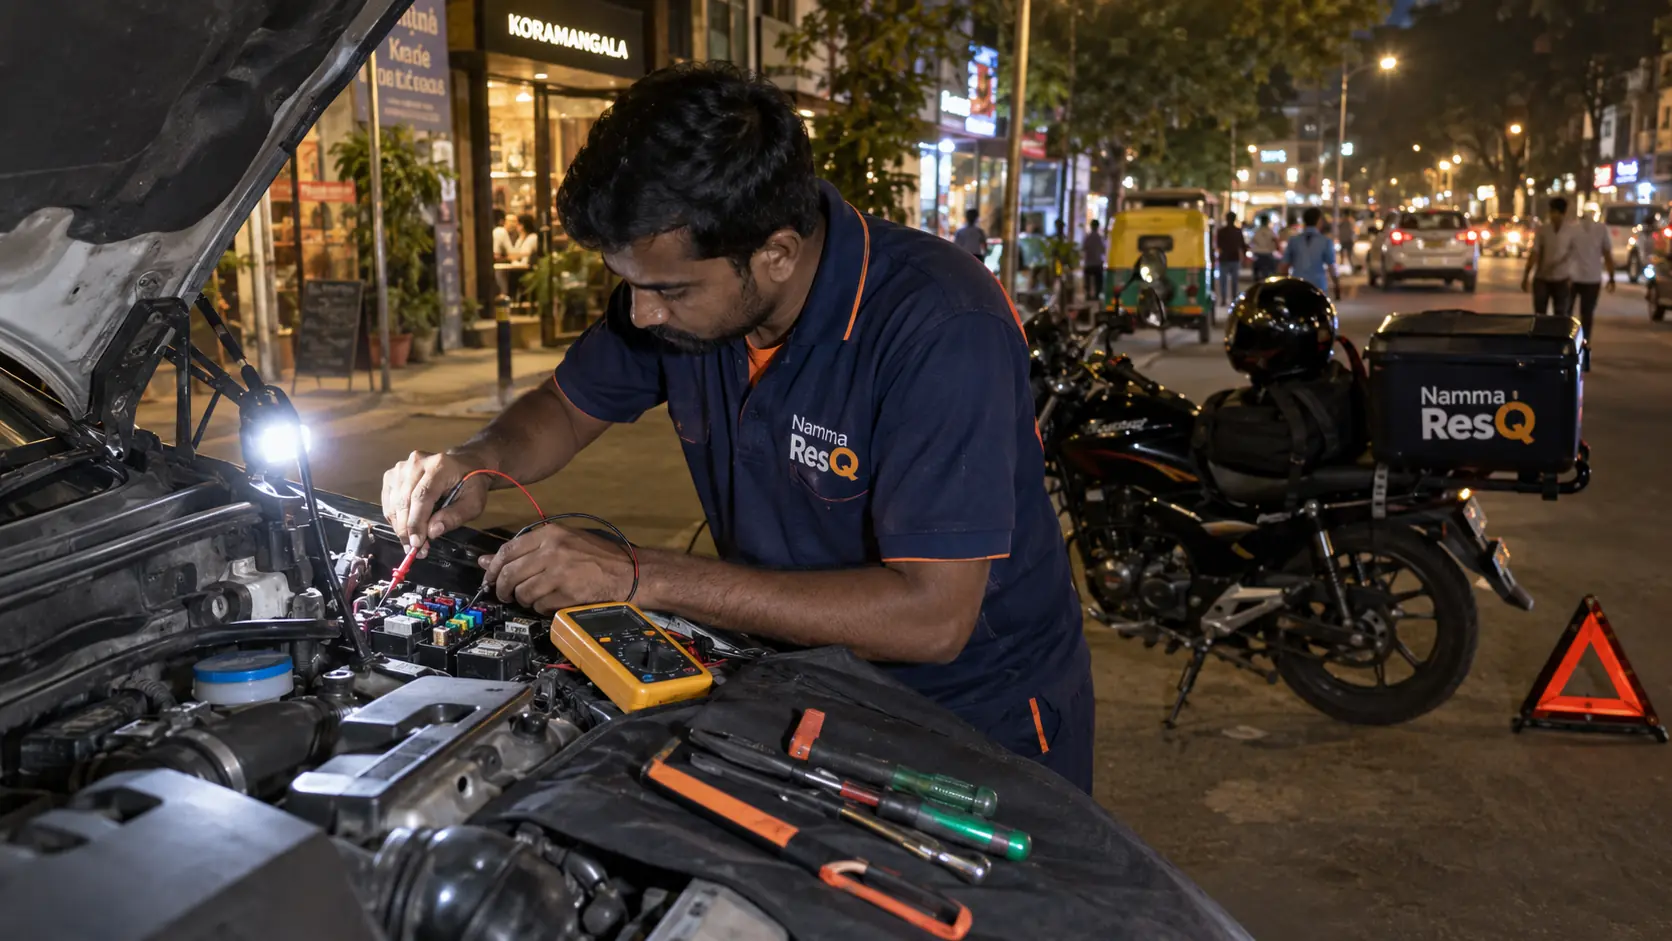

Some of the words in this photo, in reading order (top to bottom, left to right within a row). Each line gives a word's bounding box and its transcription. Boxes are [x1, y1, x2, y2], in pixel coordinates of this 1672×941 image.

[508, 13, 628, 60] KORAMANGALA
[1421, 386, 1505, 405] Namma
[792, 413, 848, 447] Namma
[1421, 401, 1535, 445] ResQ
[790, 433, 859, 481] ResQ
